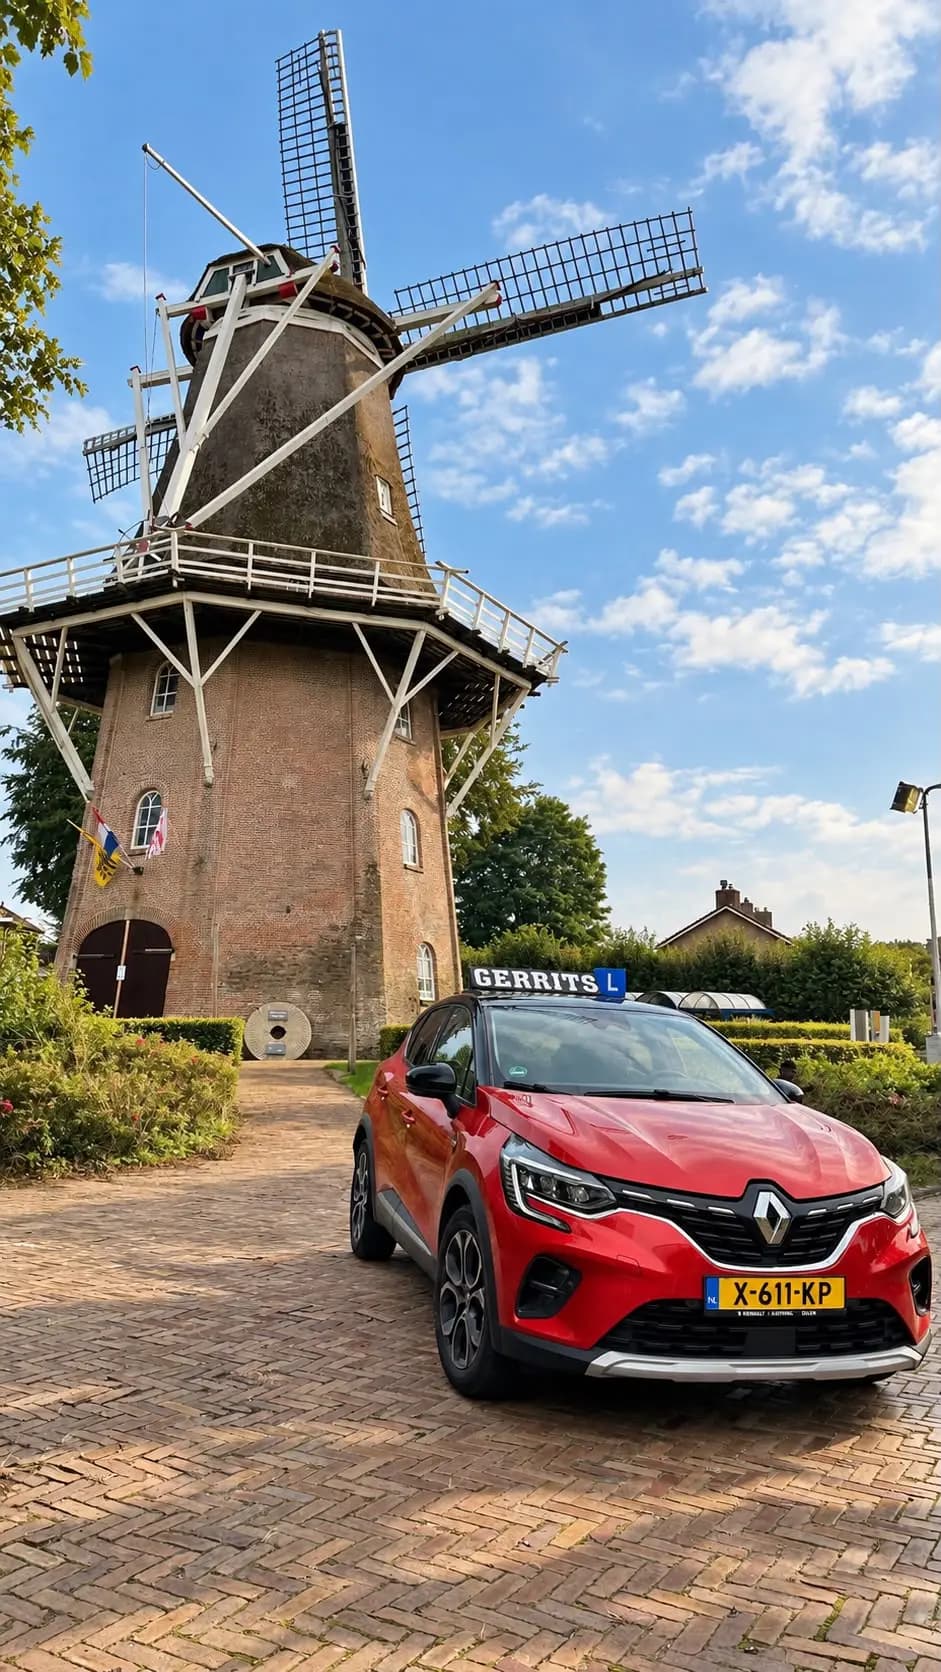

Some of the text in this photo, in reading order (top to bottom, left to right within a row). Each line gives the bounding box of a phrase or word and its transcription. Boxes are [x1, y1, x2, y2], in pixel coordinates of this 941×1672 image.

[474, 968, 599, 993] GERRITS
[607, 973, 619, 992] L
[707, 1296, 718, 1304] NL
[733, 1281, 832, 1306] X-611-KP
